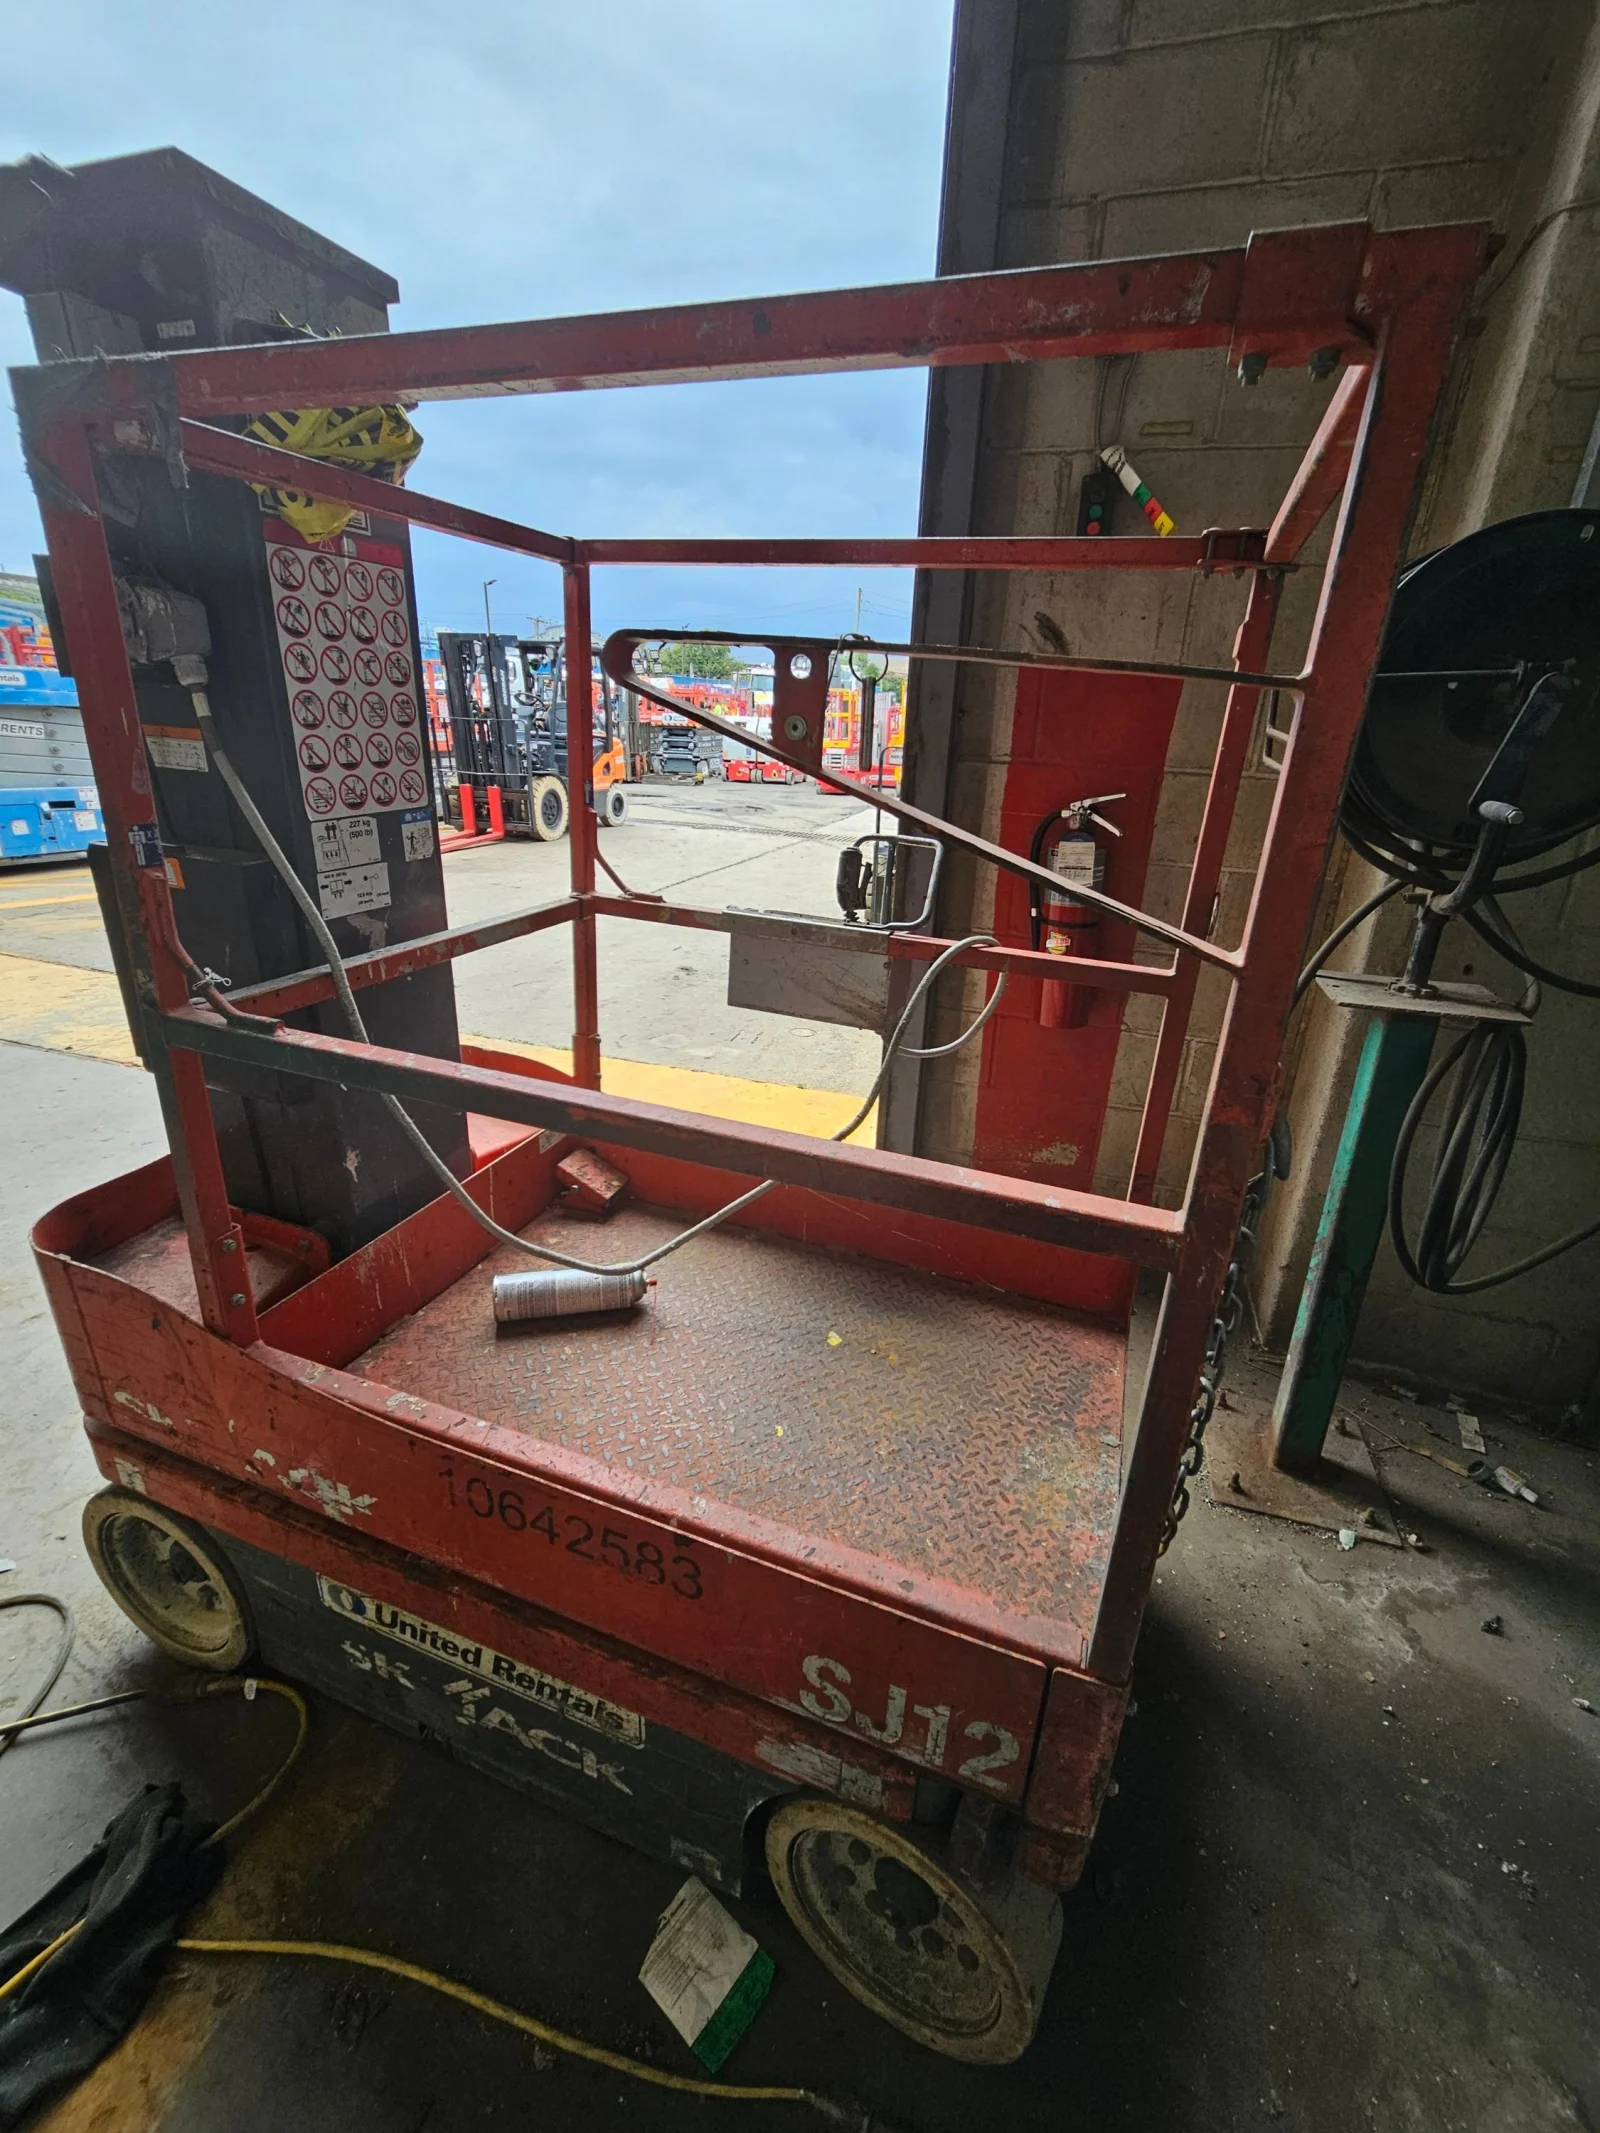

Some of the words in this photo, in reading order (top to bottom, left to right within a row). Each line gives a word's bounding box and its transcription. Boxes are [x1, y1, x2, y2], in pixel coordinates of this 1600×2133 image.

[1, 723, 43, 736] RENTS
[349, 830, 363, 840] (500
[365, 828, 373, 837] lb)
[362, 820, 371, 828] kg
[439, 1467, 704, 1600] 10642583
[374, 1603, 483, 1668] United
[492, 1654, 625, 1730] Rentals
[800, 1655, 1020, 1794] SJ12
